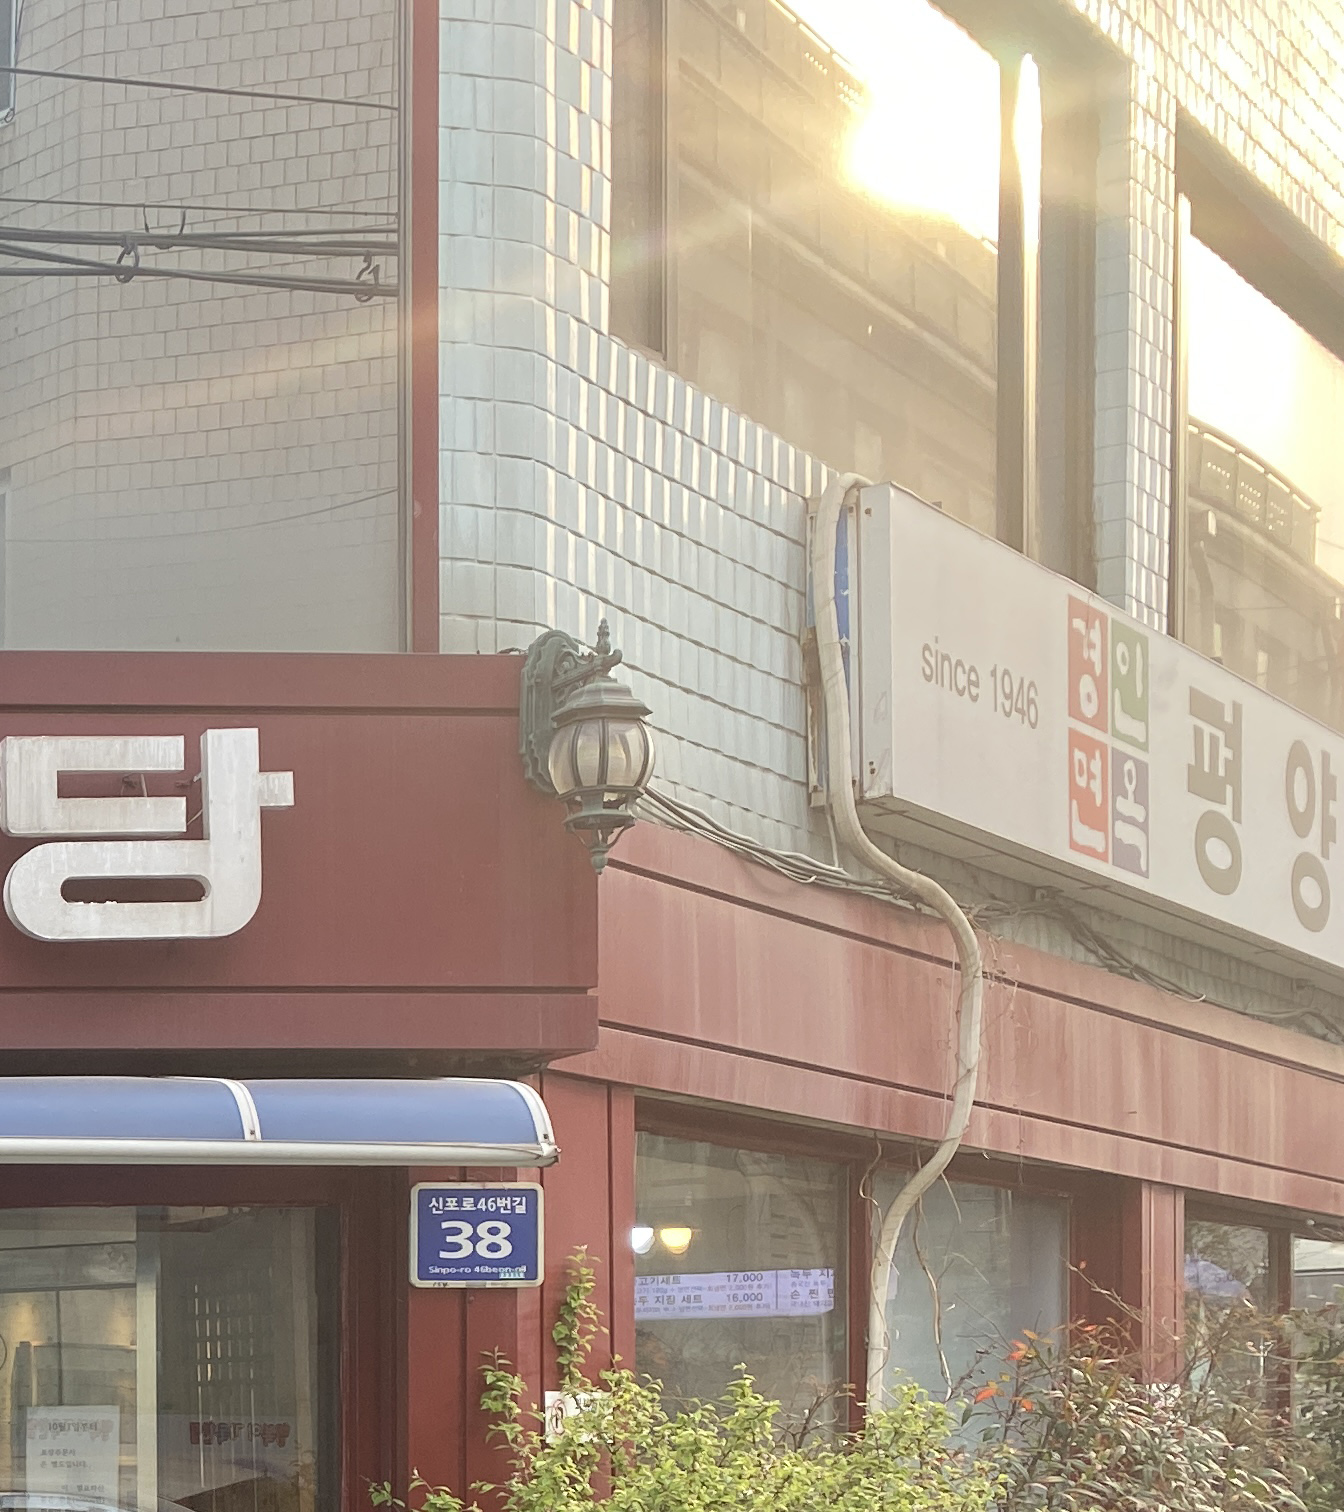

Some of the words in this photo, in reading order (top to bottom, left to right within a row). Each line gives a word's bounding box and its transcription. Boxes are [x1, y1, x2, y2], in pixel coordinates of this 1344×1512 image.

[921, 636, 980, 704] since
[989, 662, 1040, 730] 1946
[1187, 685, 1338, 933] 평양
[428, 1196, 527, 1214] 신포로46번길
[439, 1220, 513, 1259] 38
[428, 1265, 472, 1275] Sinpo-ro
[635, 1275, 681, 1287] 고기세트
[725, 1273, 764, 1284] 17,000
[726, 1293, 763, 1303] 16,000
